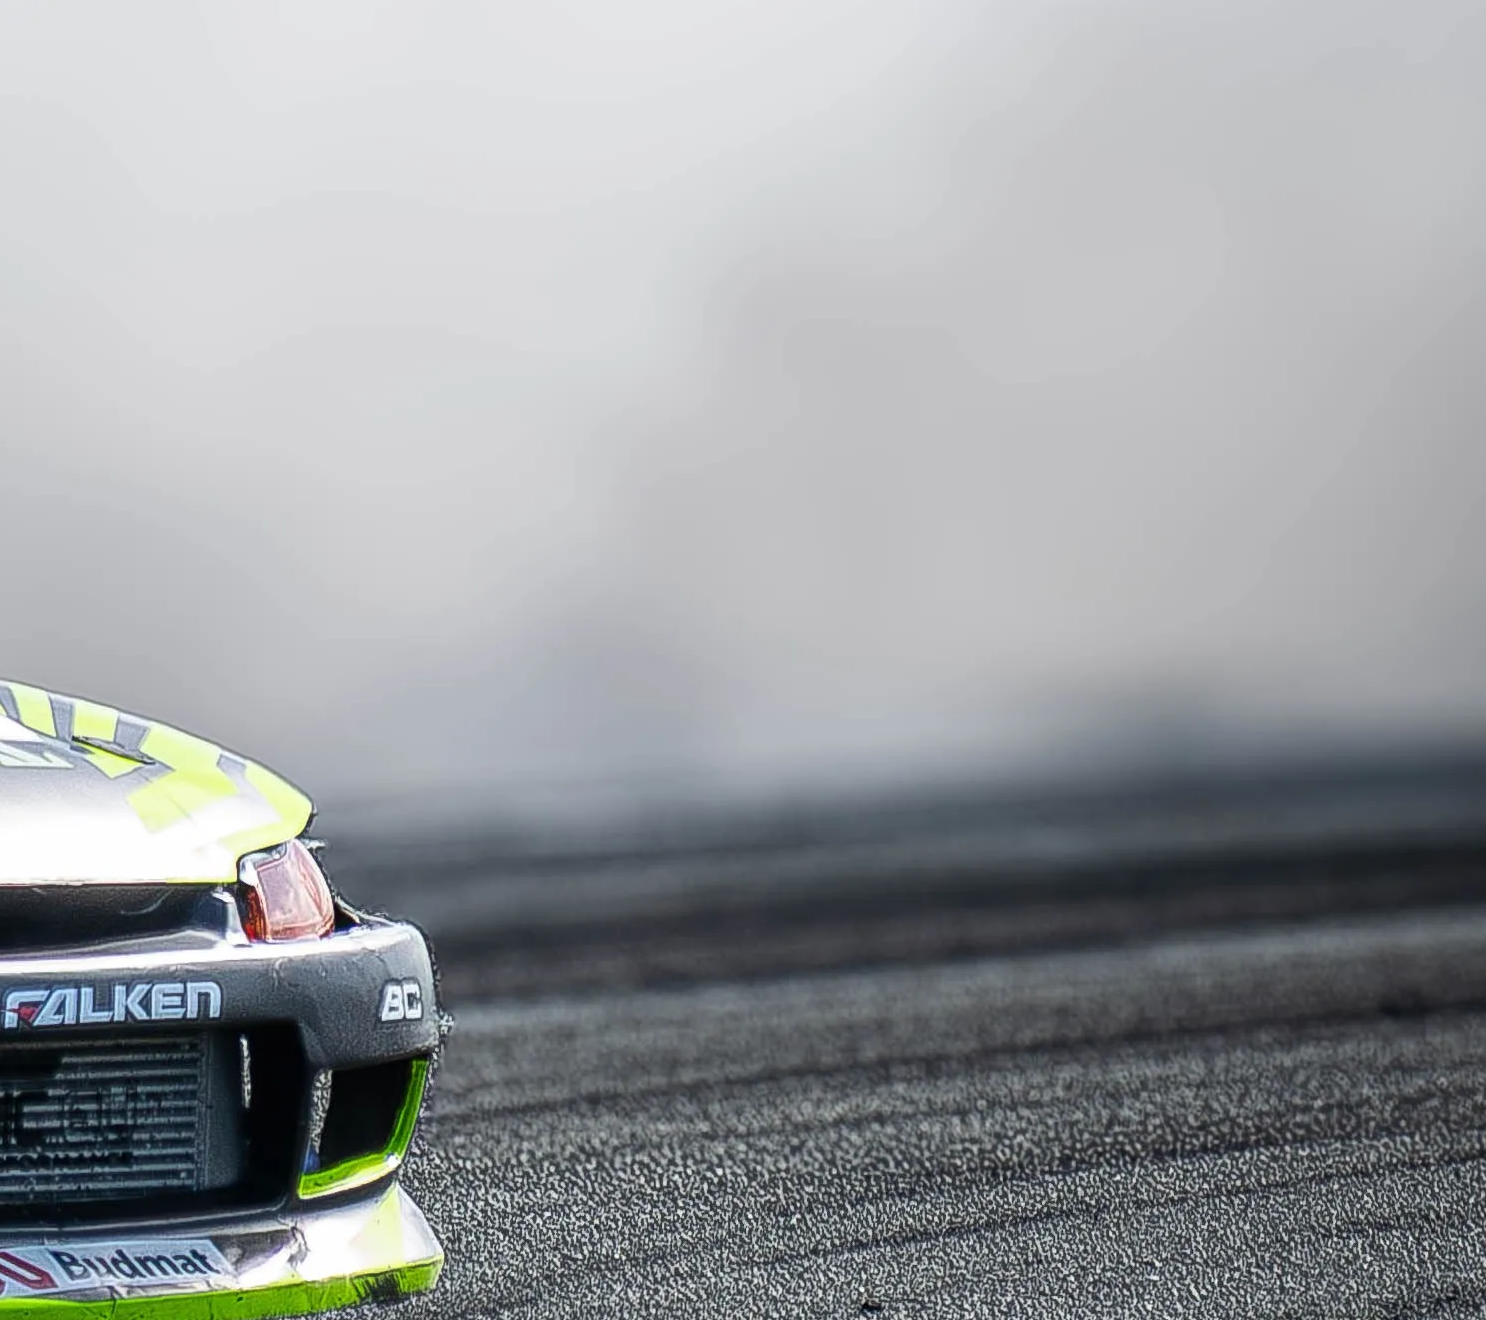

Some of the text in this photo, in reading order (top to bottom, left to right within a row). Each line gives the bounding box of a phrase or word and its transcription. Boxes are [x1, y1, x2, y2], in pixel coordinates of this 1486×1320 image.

[4, 981, 222, 1030] FALKEN
[382, 981, 423, 1022] BC
[48, 1248, 222, 1281] Budmat
